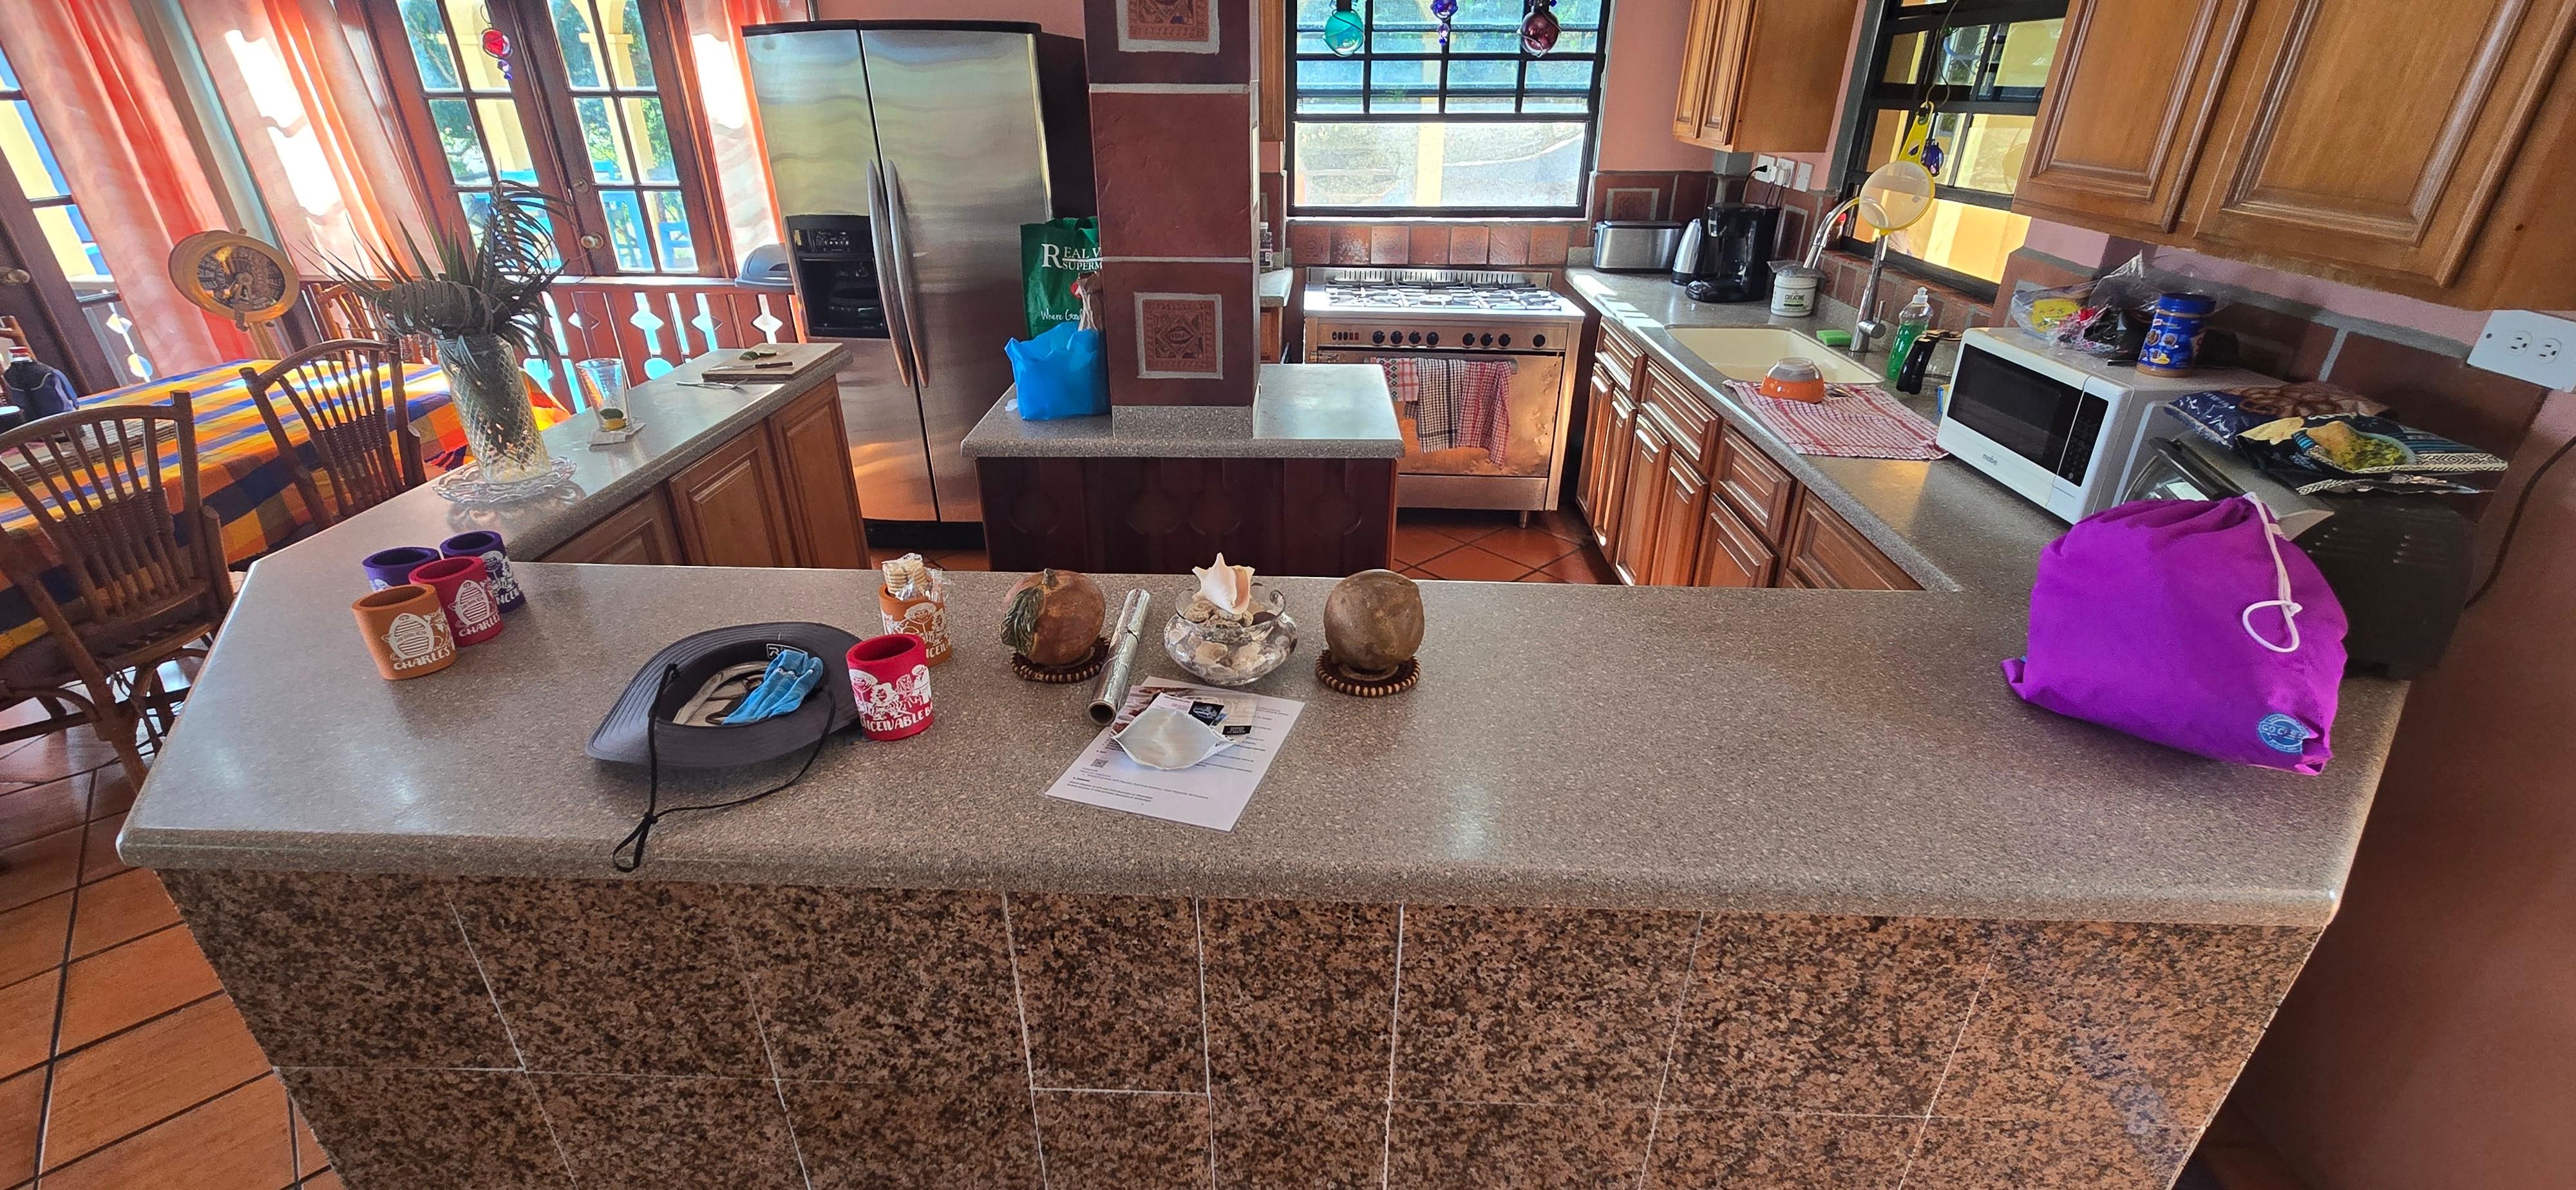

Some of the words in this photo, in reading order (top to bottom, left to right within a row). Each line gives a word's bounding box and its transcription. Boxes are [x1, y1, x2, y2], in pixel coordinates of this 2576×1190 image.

[1041, 243, 1089, 268] REAL
[1063, 261, 1102, 270] SUPERM
[1041, 307, 1064, 321] Where
[1982, 453, 1998, 466] mabe
